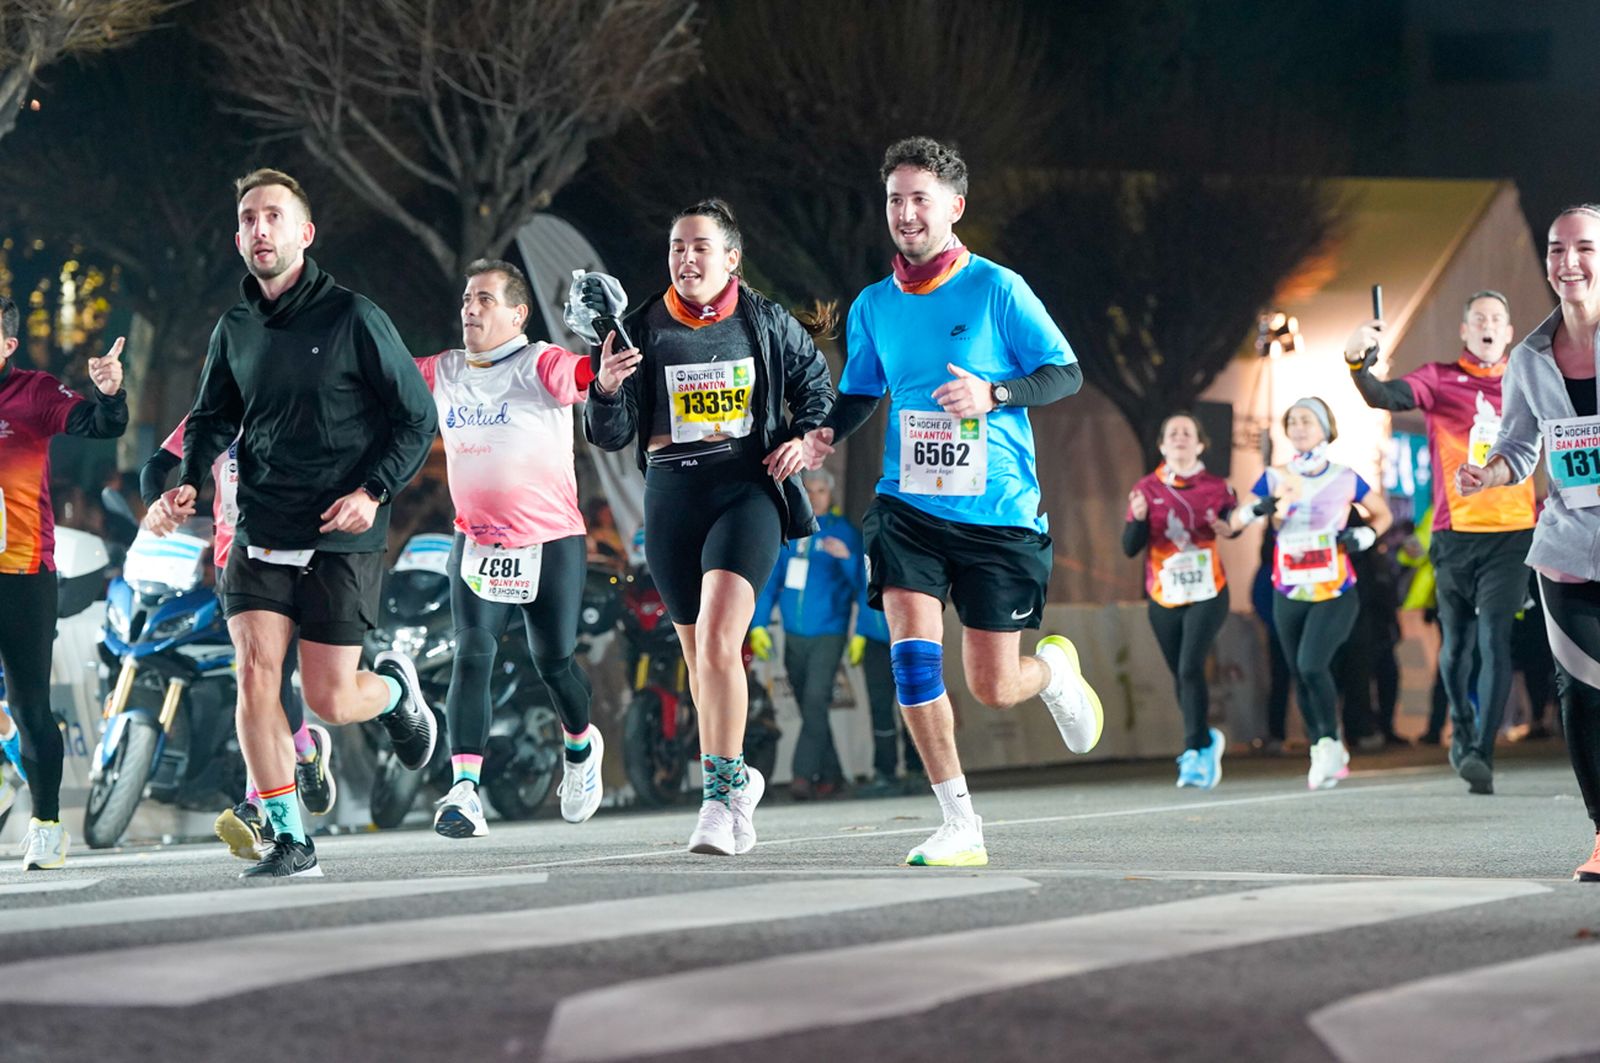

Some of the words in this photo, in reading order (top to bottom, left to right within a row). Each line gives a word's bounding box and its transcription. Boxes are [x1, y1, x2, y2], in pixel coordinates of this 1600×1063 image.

[687, 372, 713, 381] NOCHE
[678, 384, 695, 392] SAN
[680, 389, 745, 414] 13359
[455, 402, 511, 428] Salud
[917, 420, 940, 429] NOCHE
[942, 421, 952, 429] DE
[909, 431, 922, 439] SAN
[1565, 427, 1590, 437] NOCHE
[1556, 440, 1572, 450] SAN
[914, 441, 970, 467] 6562
[681, 459, 698, 467] FILA
[479, 557, 522, 578] 1837
[514, 580, 530, 588] SAN
[498, 588, 520, 596] NOCHE
